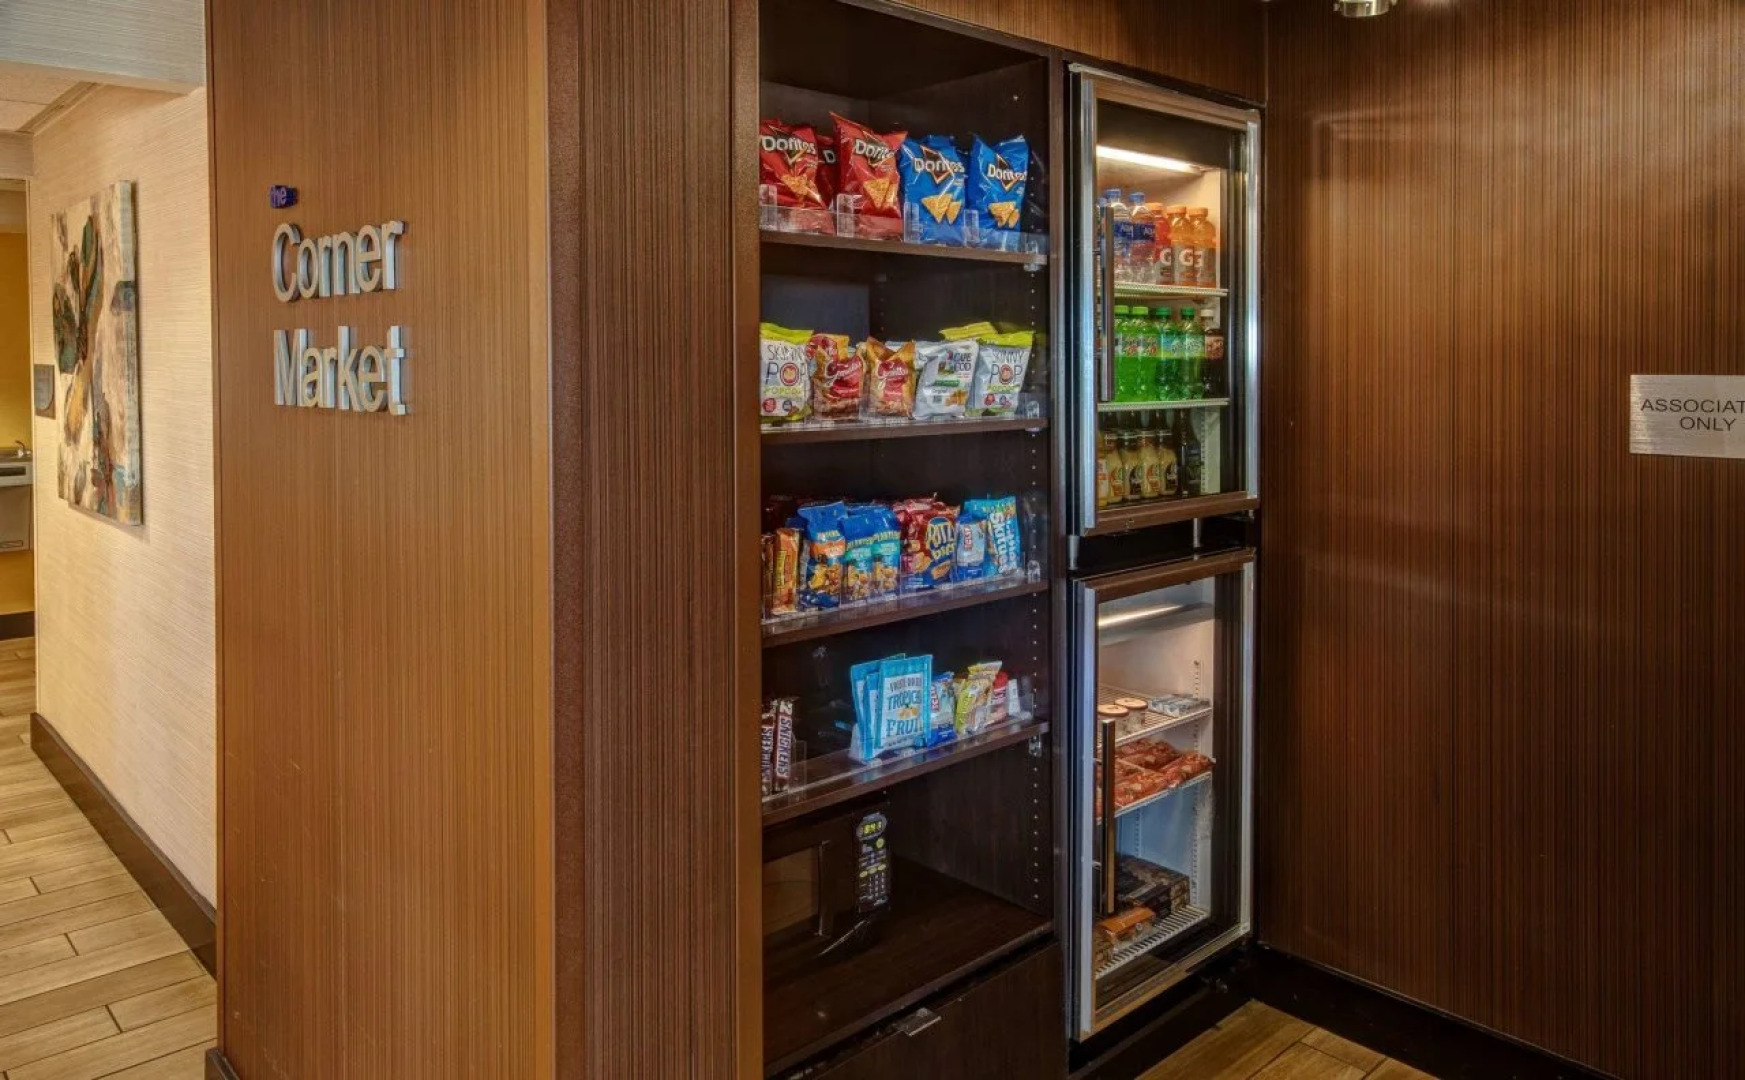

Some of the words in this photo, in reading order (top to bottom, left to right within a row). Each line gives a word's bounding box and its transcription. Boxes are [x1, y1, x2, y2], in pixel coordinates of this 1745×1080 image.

[761, 135, 817, 154] Doritos
[855, 138, 895, 160] Dorito
[914, 157, 965, 173] Doritos
[272, 220, 405, 302] Corner
[273, 325, 407, 415] Market
[1641, 398, 1745, 413] ASSOCIAT
[1680, 416, 1736, 431] ONLY
[926, 522, 955, 548] RITZ
[779, 714, 792, 774] SNICKERS
